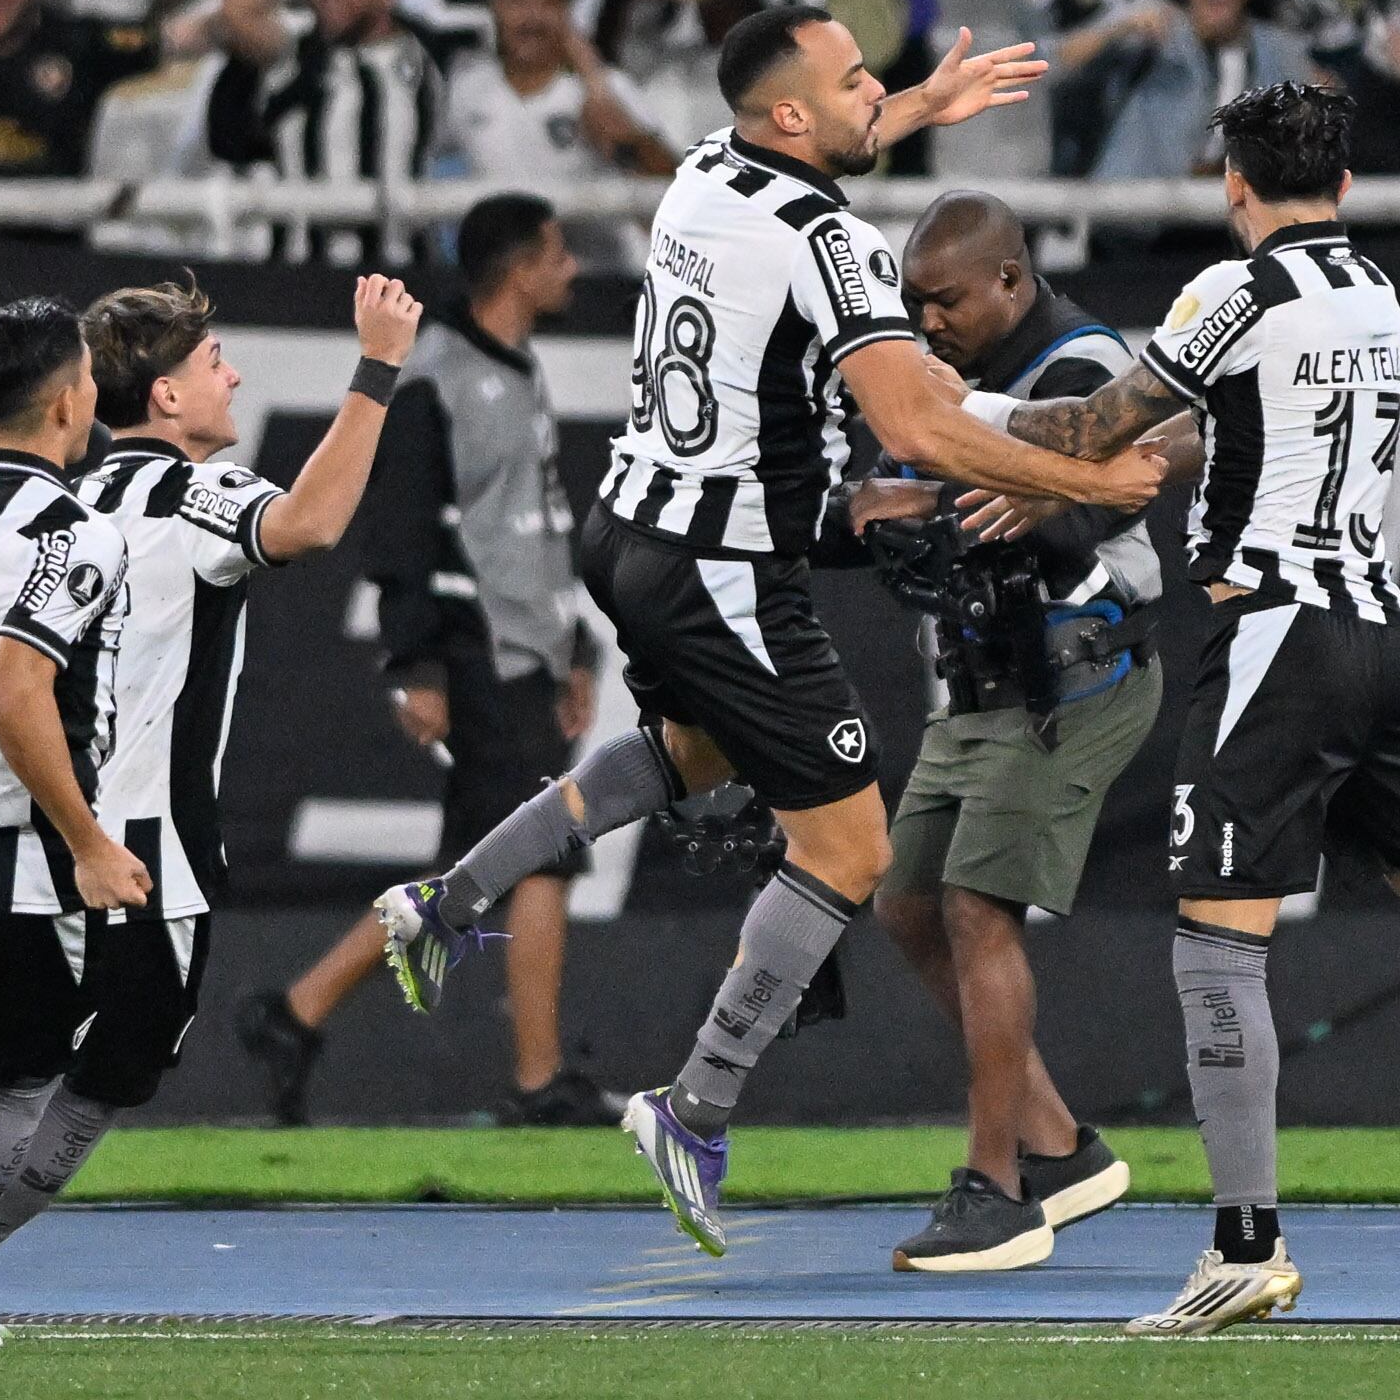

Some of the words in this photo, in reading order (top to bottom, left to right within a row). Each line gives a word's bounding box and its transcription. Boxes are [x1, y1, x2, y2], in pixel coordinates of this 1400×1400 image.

[656, 234, 716, 298] CABRAL
[826, 228, 871, 315] Centrum
[631, 270, 719, 458] 98
[1179, 288, 1253, 369] Centrum
[1292, 348, 1364, 386] ALEX
[25, 529, 76, 612] Centrum
[1220, 822, 1234, 877] Reebok
[1203, 989, 1245, 1048] Lifefit
